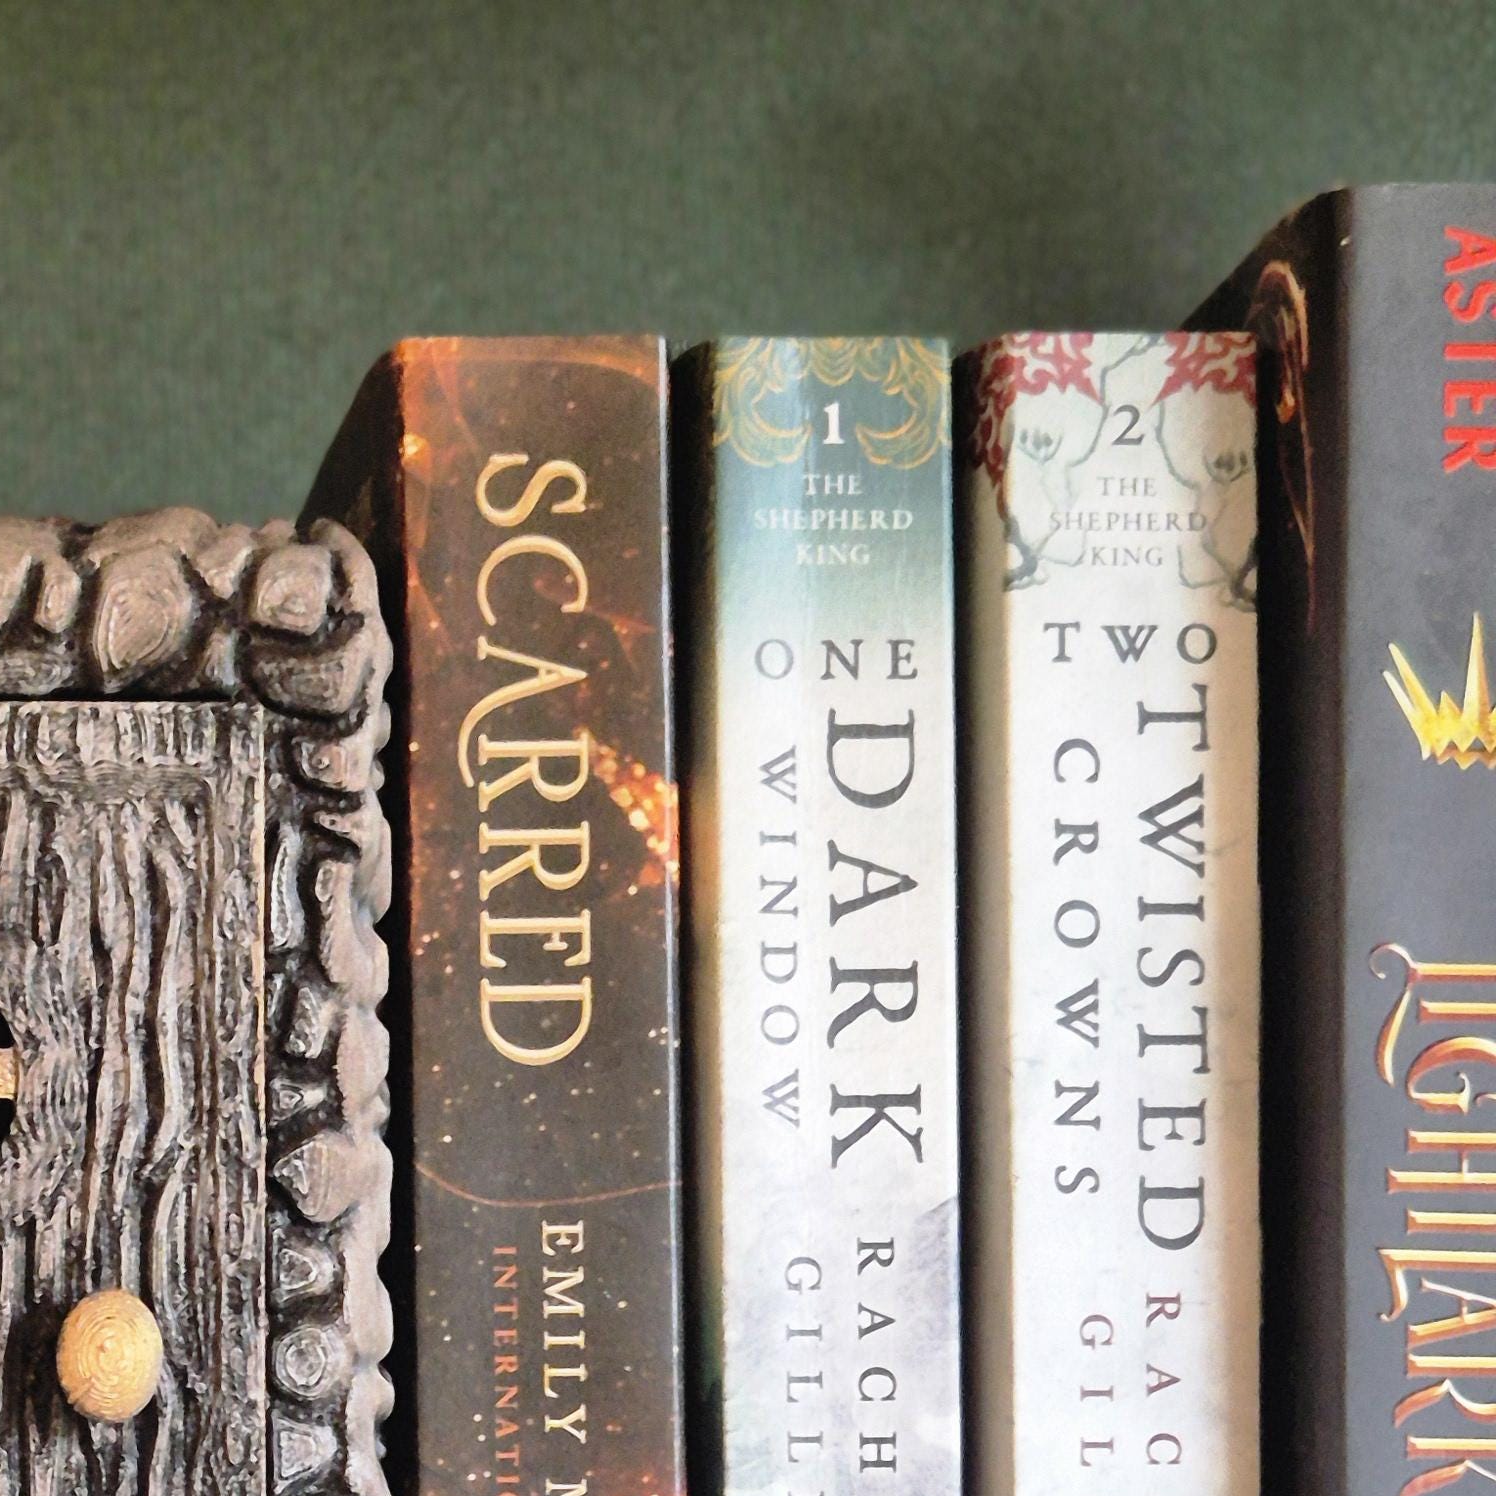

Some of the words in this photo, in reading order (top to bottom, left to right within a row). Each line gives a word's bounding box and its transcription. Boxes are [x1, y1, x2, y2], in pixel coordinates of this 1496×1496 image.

[823, 401, 845, 445] 1
[1111, 404, 1146, 446] 2
[803, 474, 863, 496] THE
[1097, 476, 1158, 497] THE
[754, 508, 913, 530] SHEPHERD
[1049, 511, 1207, 531] SHEPHERD
[795, 544, 870, 566] KING
[1090, 546, 1164, 567] KING
[755, 638, 918, 681] ONE
[1043, 621, 1218, 665] TWO
[458, 452, 593, 1066] SCARRED
[758, 745, 802, 1129] WINDOW
[827, 708, 926, 1169] DARK
[1053, 739, 1101, 1195] CROWNS
[1135, 683, 1211, 1252] TWISTED
[539, 1219, 588, 1443] EMILY
